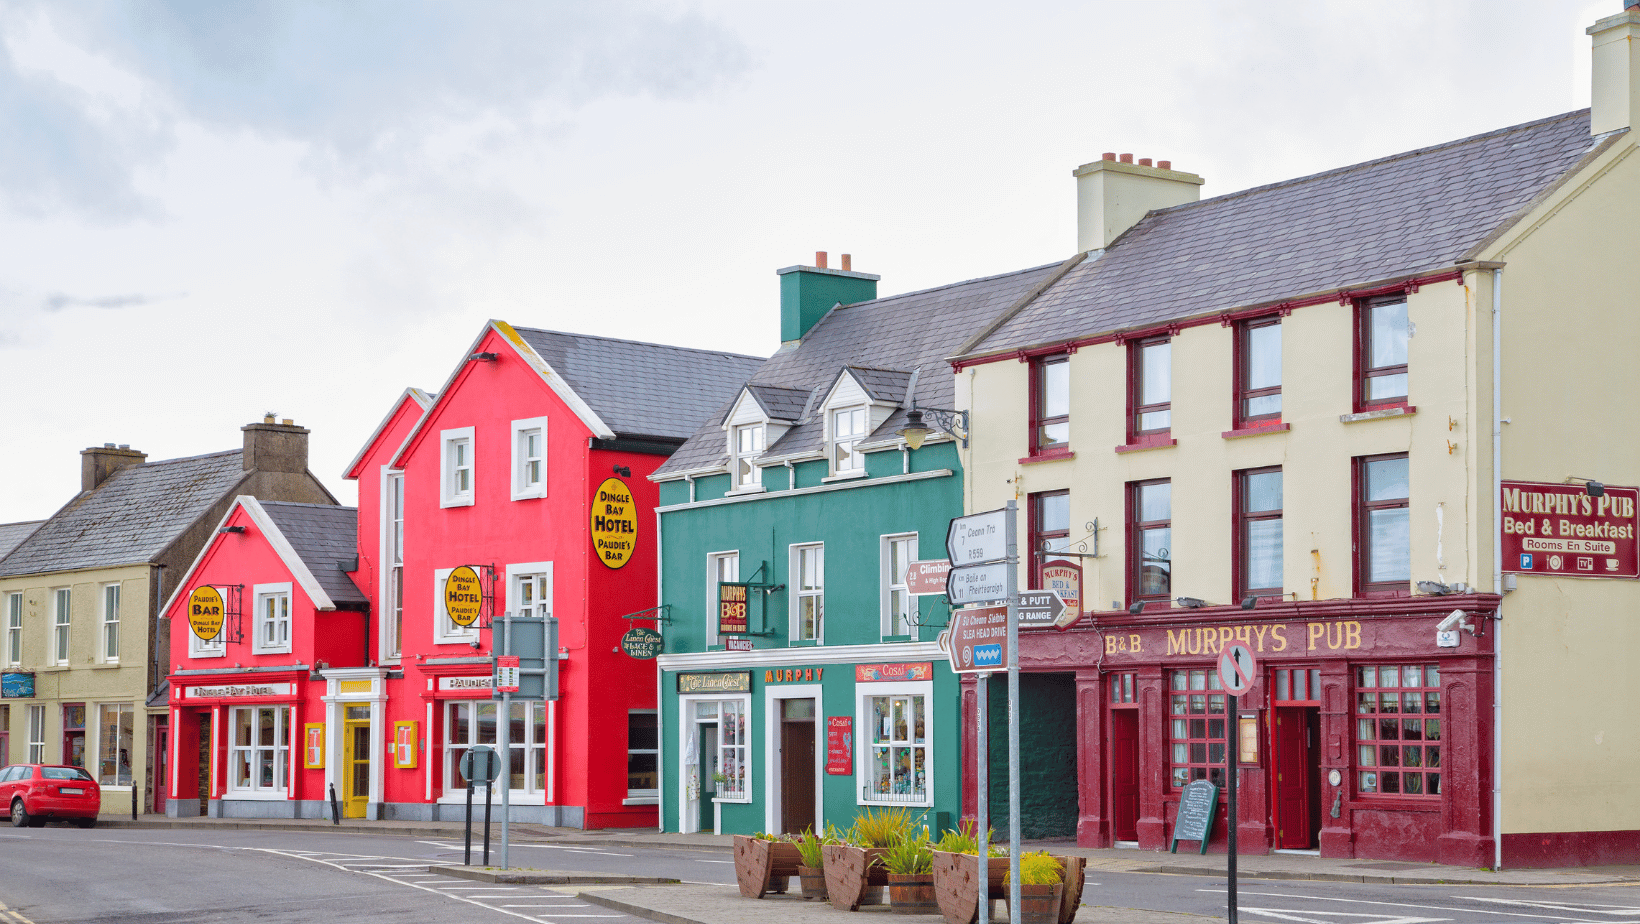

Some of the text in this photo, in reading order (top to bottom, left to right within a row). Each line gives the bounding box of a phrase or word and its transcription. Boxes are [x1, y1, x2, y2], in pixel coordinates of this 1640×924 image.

[600, 491, 630, 503] DINGLE
[1502, 488, 1634, 518] MURPHY'S PUB
[605, 504, 624, 515] BAY
[594, 515, 634, 533] HOTEL
[1504, 517, 1633, 539] Bed & Breakfast
[968, 527, 985, 538] Ceann
[962, 536, 965, 545] 7
[1527, 539, 1610, 552] Rooms En Suite
[605, 551, 623, 560] BAR
[920, 562, 951, 574] Climbin
[1579, 560, 1588, 568] TV
[452, 575, 476, 583] DINGLE
[1044, 569, 1078, 581] MURPHY'S
[1052, 580, 1070, 589] BED &
[449, 591, 479, 602] HOTEL
[959, 589, 963, 598] 11
[1021, 596, 1051, 605] & PUTT
[192, 604, 220, 616] BAR
[721, 602, 746, 618] B&B
[1026, 612, 1052, 620] RANGE
[625, 634, 643, 642] Linen
[963, 626, 1006, 639] SLEA HEAD DRIVE
[1167, 624, 1287, 656] MURPHY'S
[1308, 621, 1362, 650] PUB
[702, 675, 722, 687] Linen
[765, 668, 823, 683] MURPHY
